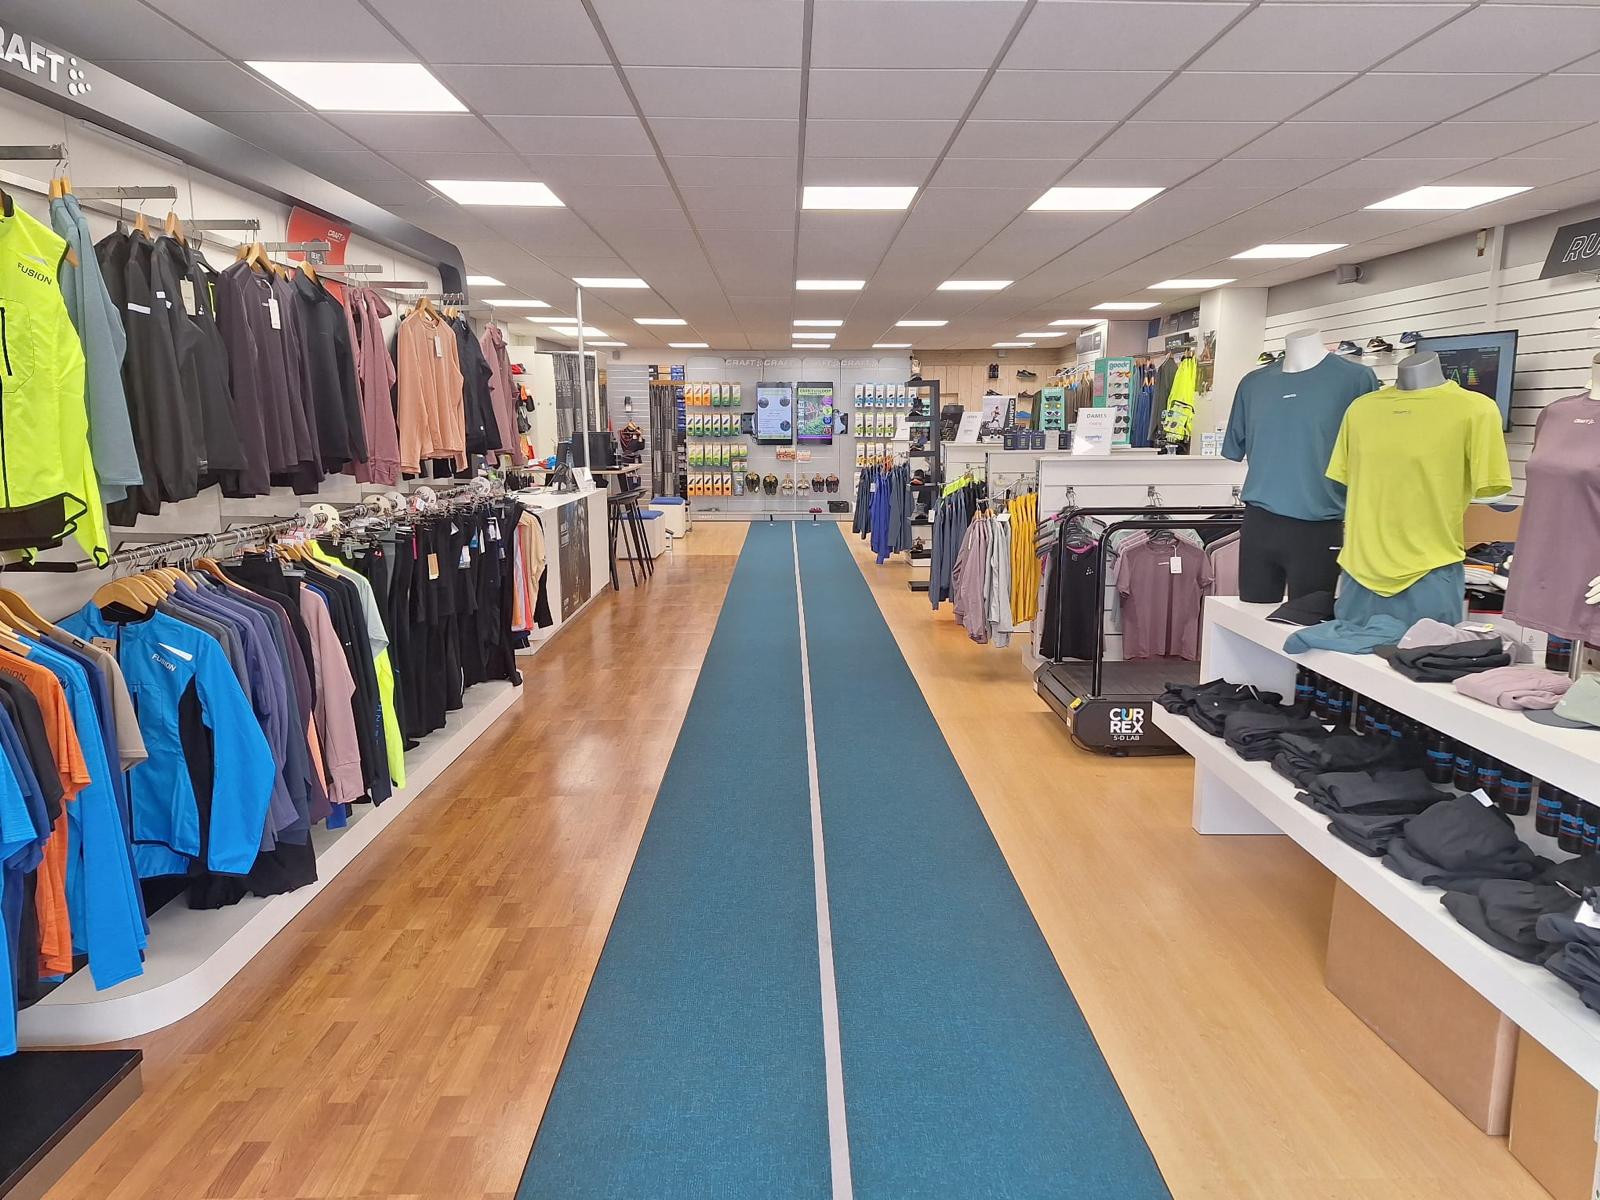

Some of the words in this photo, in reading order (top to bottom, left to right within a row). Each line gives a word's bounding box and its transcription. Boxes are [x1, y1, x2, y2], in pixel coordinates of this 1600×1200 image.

[0, 26, 65, 83] AFT
[327, 229, 343, 240] CRAFT
[1562, 232, 1600, 262] RU
[17, 262, 52, 285] FUSION
[152, 653, 177, 671] FUSION
[1110, 708, 1144, 721] CUR
[1110, 721, 1144, 733] REX
